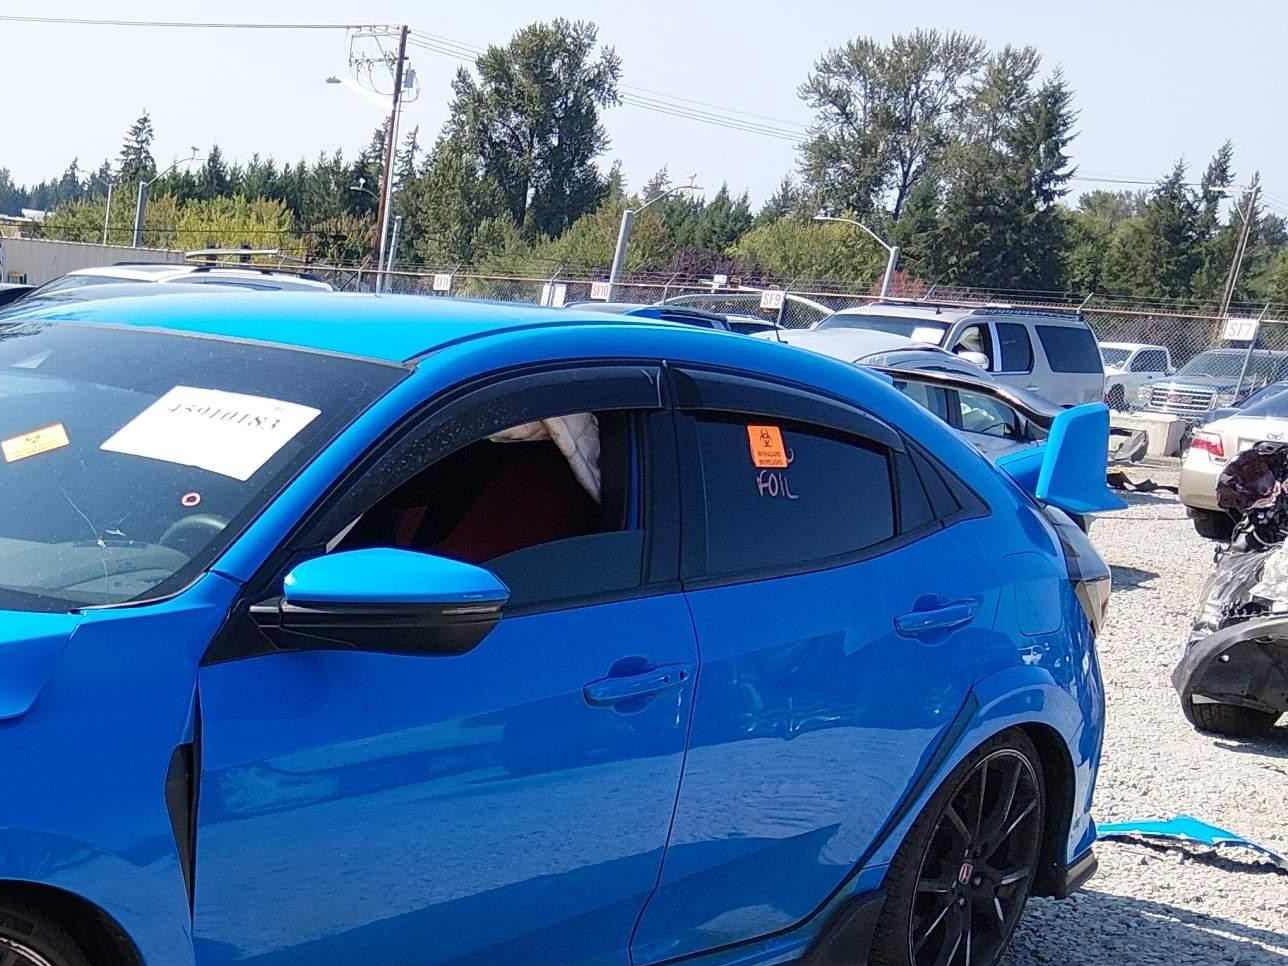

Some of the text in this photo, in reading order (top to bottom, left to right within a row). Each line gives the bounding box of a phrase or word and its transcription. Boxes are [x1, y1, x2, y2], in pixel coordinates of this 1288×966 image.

[763, 293, 781, 305] SF9
[1228, 322, 1253, 337] SF7
[756, 469, 799, 499] FOIL
